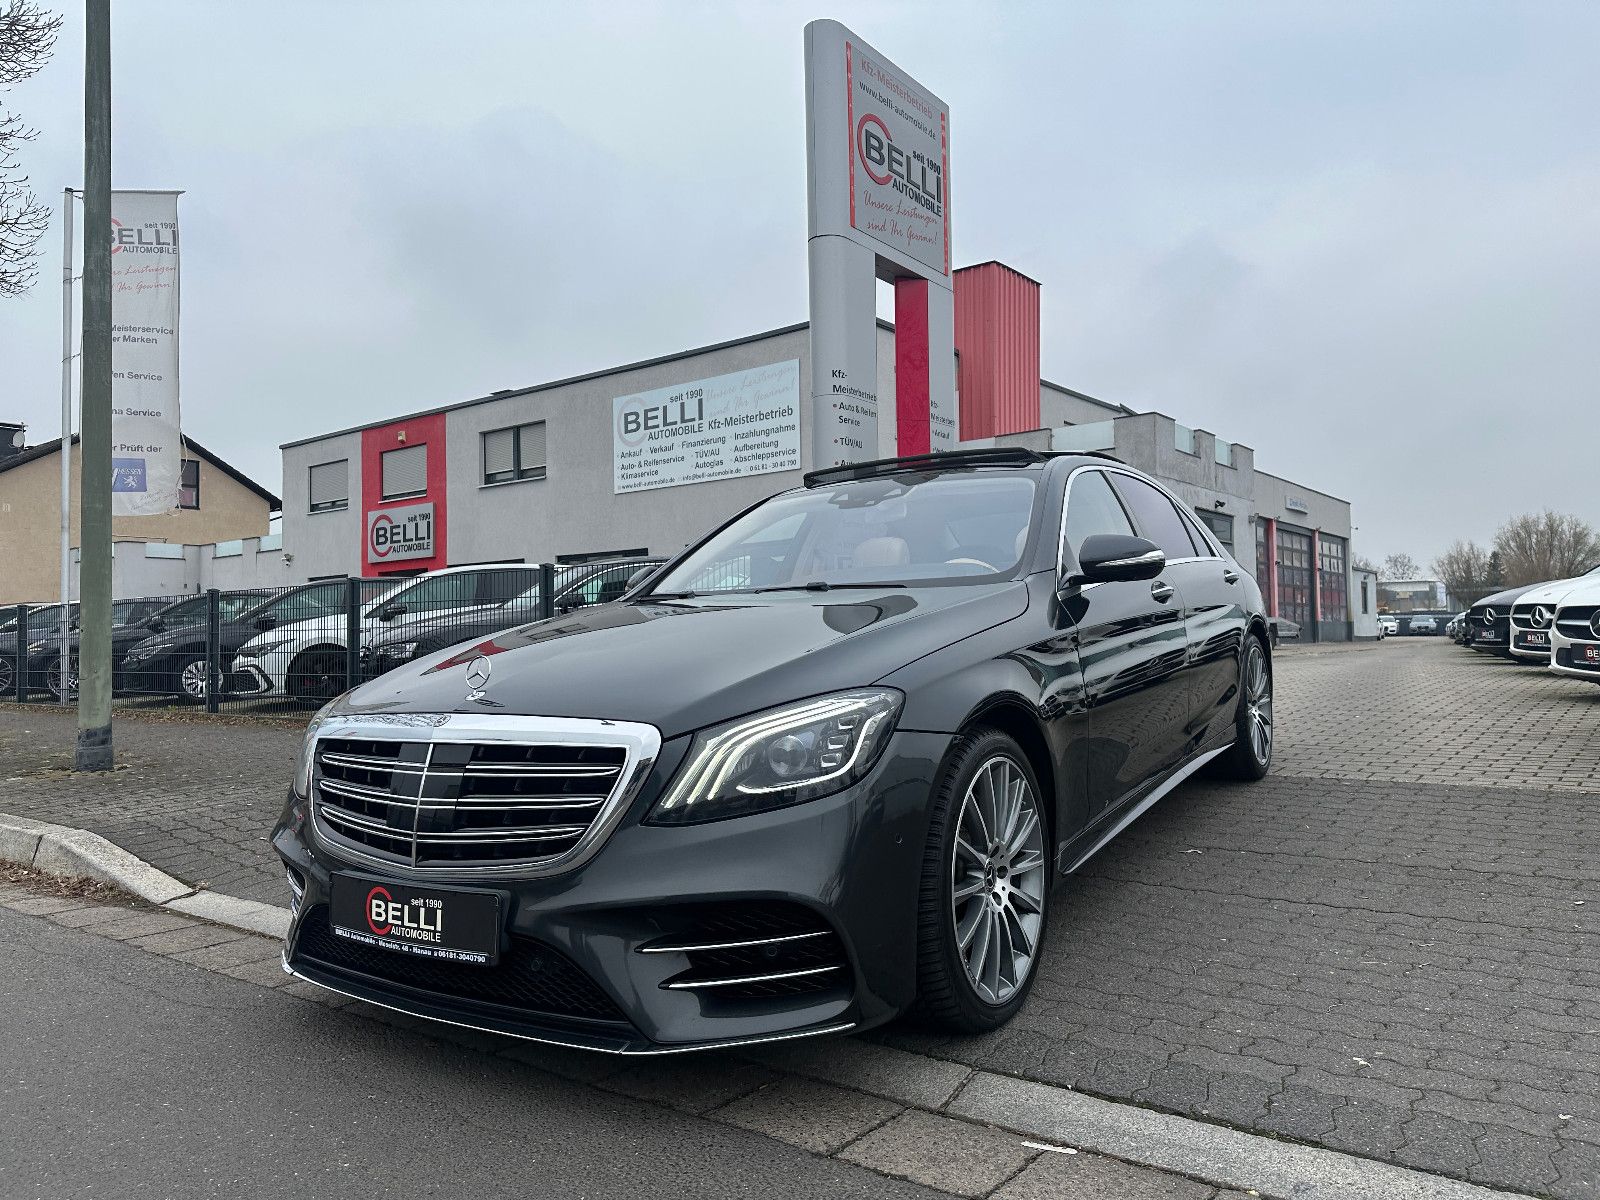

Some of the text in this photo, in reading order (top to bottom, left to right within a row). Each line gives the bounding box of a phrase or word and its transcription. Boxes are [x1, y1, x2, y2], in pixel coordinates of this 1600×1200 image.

[861, 58, 934, 120] Kfz-Meisterbetrieb
[859, 80, 937, 140] www.belli-automobile.de
[865, 128, 942, 204] BELLI
[892, 177, 942, 218] AUTOMOBILE
[122, 245, 177, 255] AUTOMOBILE
[122, 335, 158, 345] Marken
[127, 371, 163, 381] Service
[832, 369, 848, 379] Kfz-
[669, 388, 703, 404] seit 1990
[832, 384, 877, 402] Meisterbetrieb
[125, 407, 162, 418] Service
[623, 397, 704, 435] BELLI
[708, 404, 794, 431] Kfz-Meisterbetrieb
[838, 415, 861, 427] Service
[620, 424, 796, 459] Ankauf Verkauf Finanzierung Inzahlungnahme
[647, 422, 704, 442] AUTOMOBILE
[120, 443, 144, 452] Prüft
[146, 445, 163, 453] der
[643, 455, 685, 468] Reifenservice
[734, 440, 779, 453] Aufbereitung
[620, 448, 797, 480] Klimaservice Autoglas Abschleppservice
[375, 521, 431, 546] BELLI
[391, 541, 431, 554] AUTOMOBILE
[410, 898, 443, 909] seit 1990
[371, 899, 442, 932] BELLI
[390, 926, 442, 943] AUTOMOBILE
